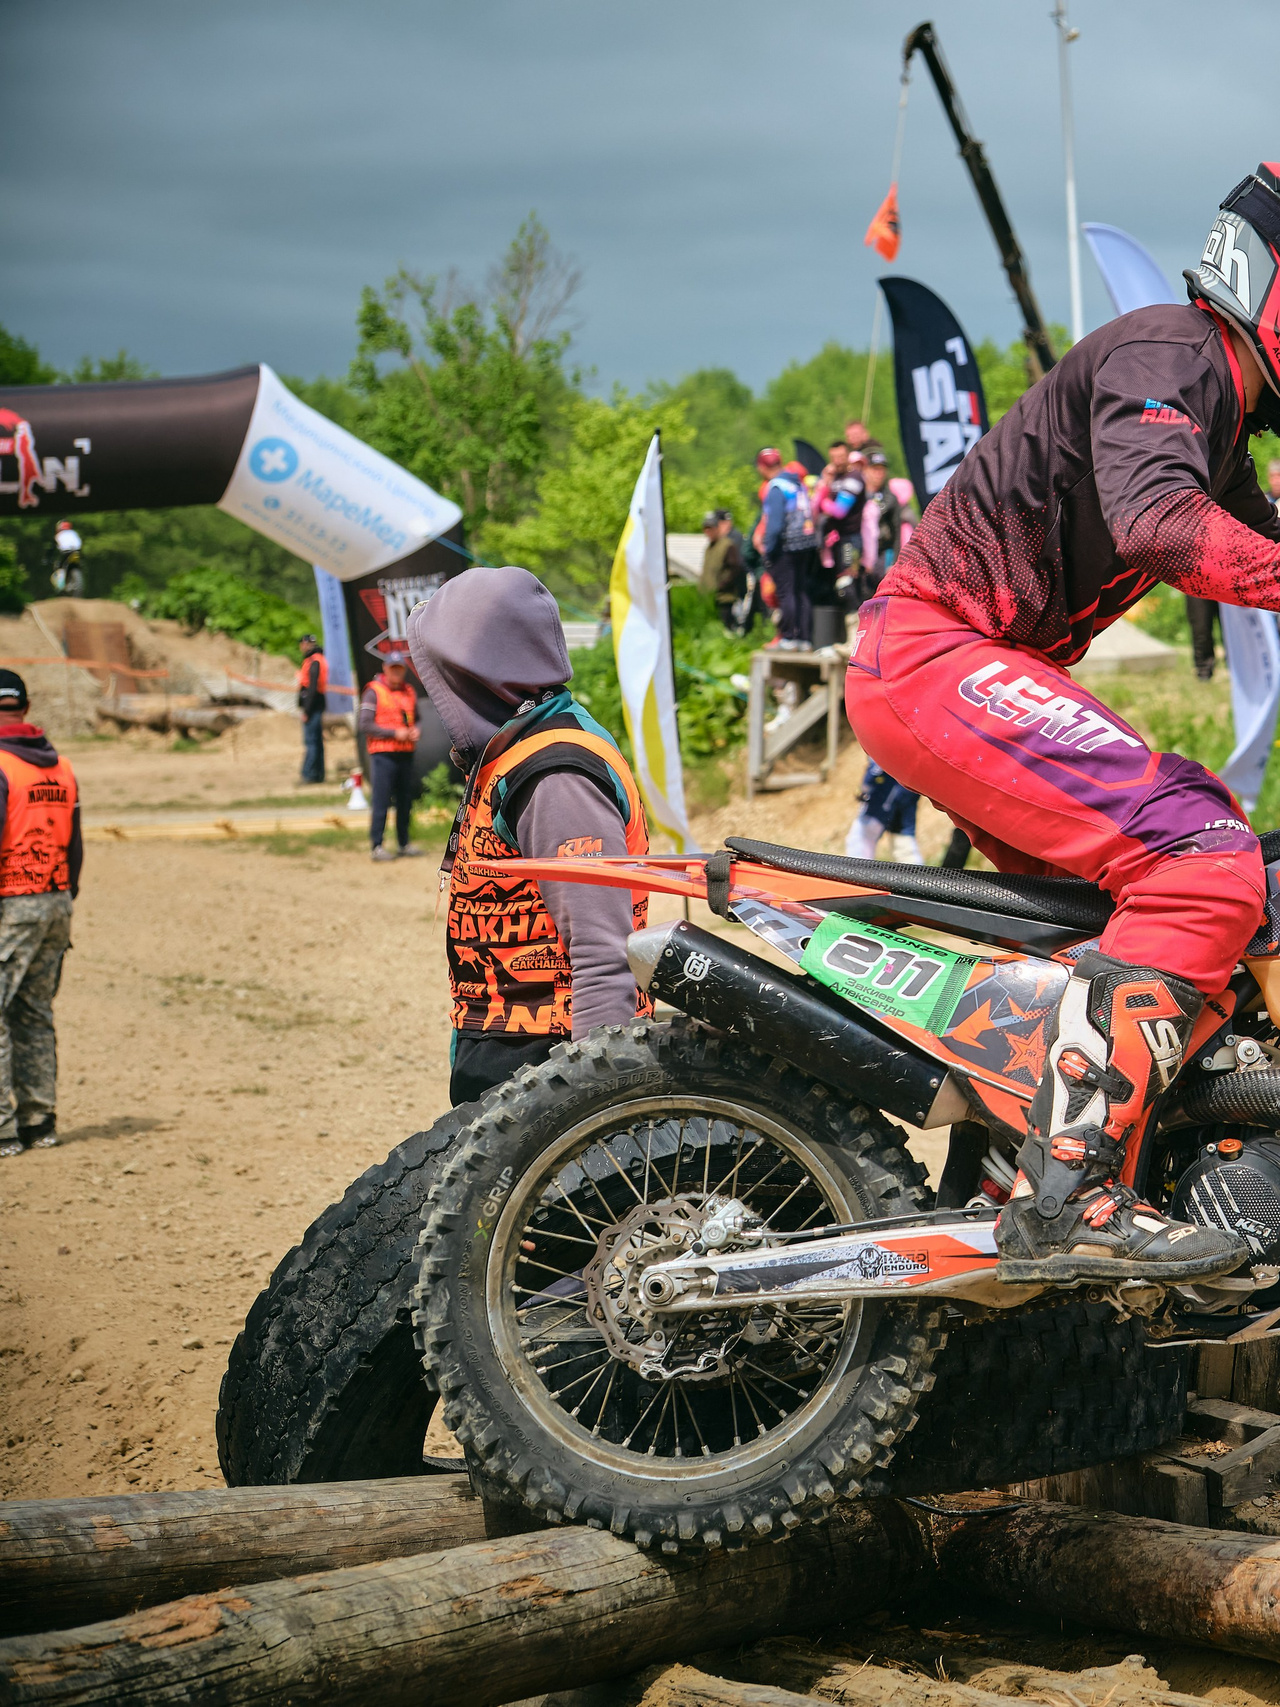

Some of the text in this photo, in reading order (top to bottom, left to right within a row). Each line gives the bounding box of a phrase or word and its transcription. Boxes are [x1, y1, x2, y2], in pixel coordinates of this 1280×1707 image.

[958, 660, 1143, 755] LEATT
[557, 836, 603, 858] KTM
[449, 910, 558, 943] SAKHA
[822, 932, 946, 1001] 211
[829, 981, 906, 1018] Александр
[844, 977, 895, 1003] Закиев
[1205, 1000, 1229, 1020] KTM
[519, 1095, 581, 1145] SUPER
[884, 1262, 927, 1271] ENDURO
